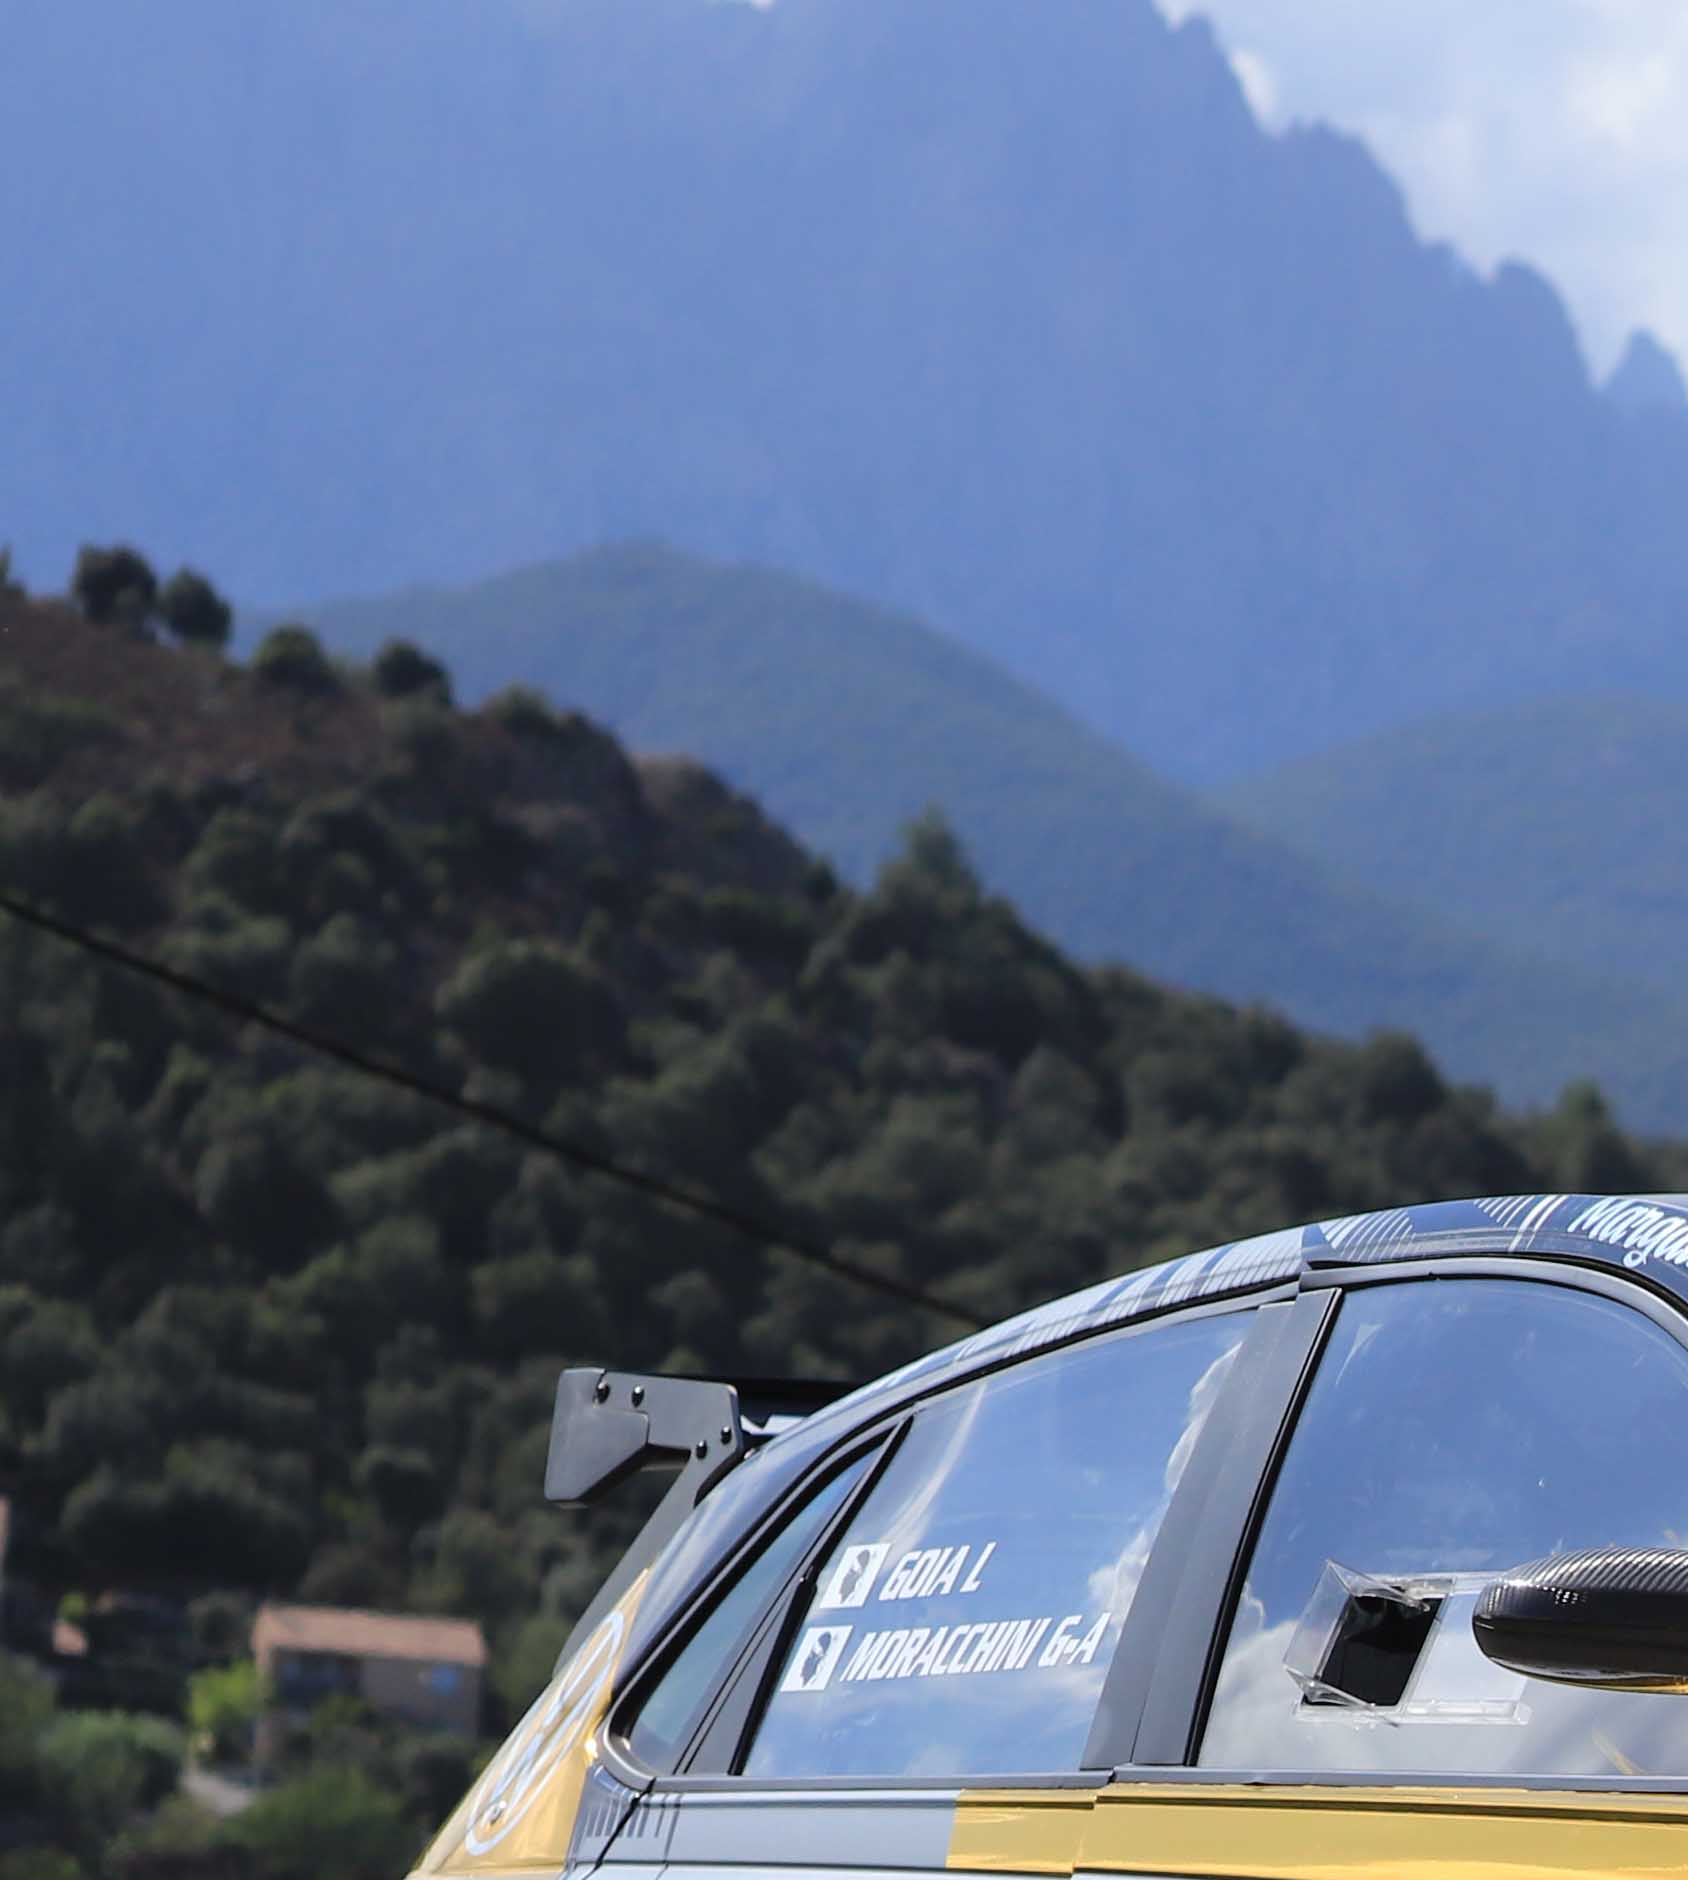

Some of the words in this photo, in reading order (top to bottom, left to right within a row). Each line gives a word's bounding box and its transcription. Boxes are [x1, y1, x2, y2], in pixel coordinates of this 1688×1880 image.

[960, 1541, 997, 1593] L
[840, 1618, 1052, 1682] MORACCHINI
[1037, 1612, 1112, 1667] G-A
